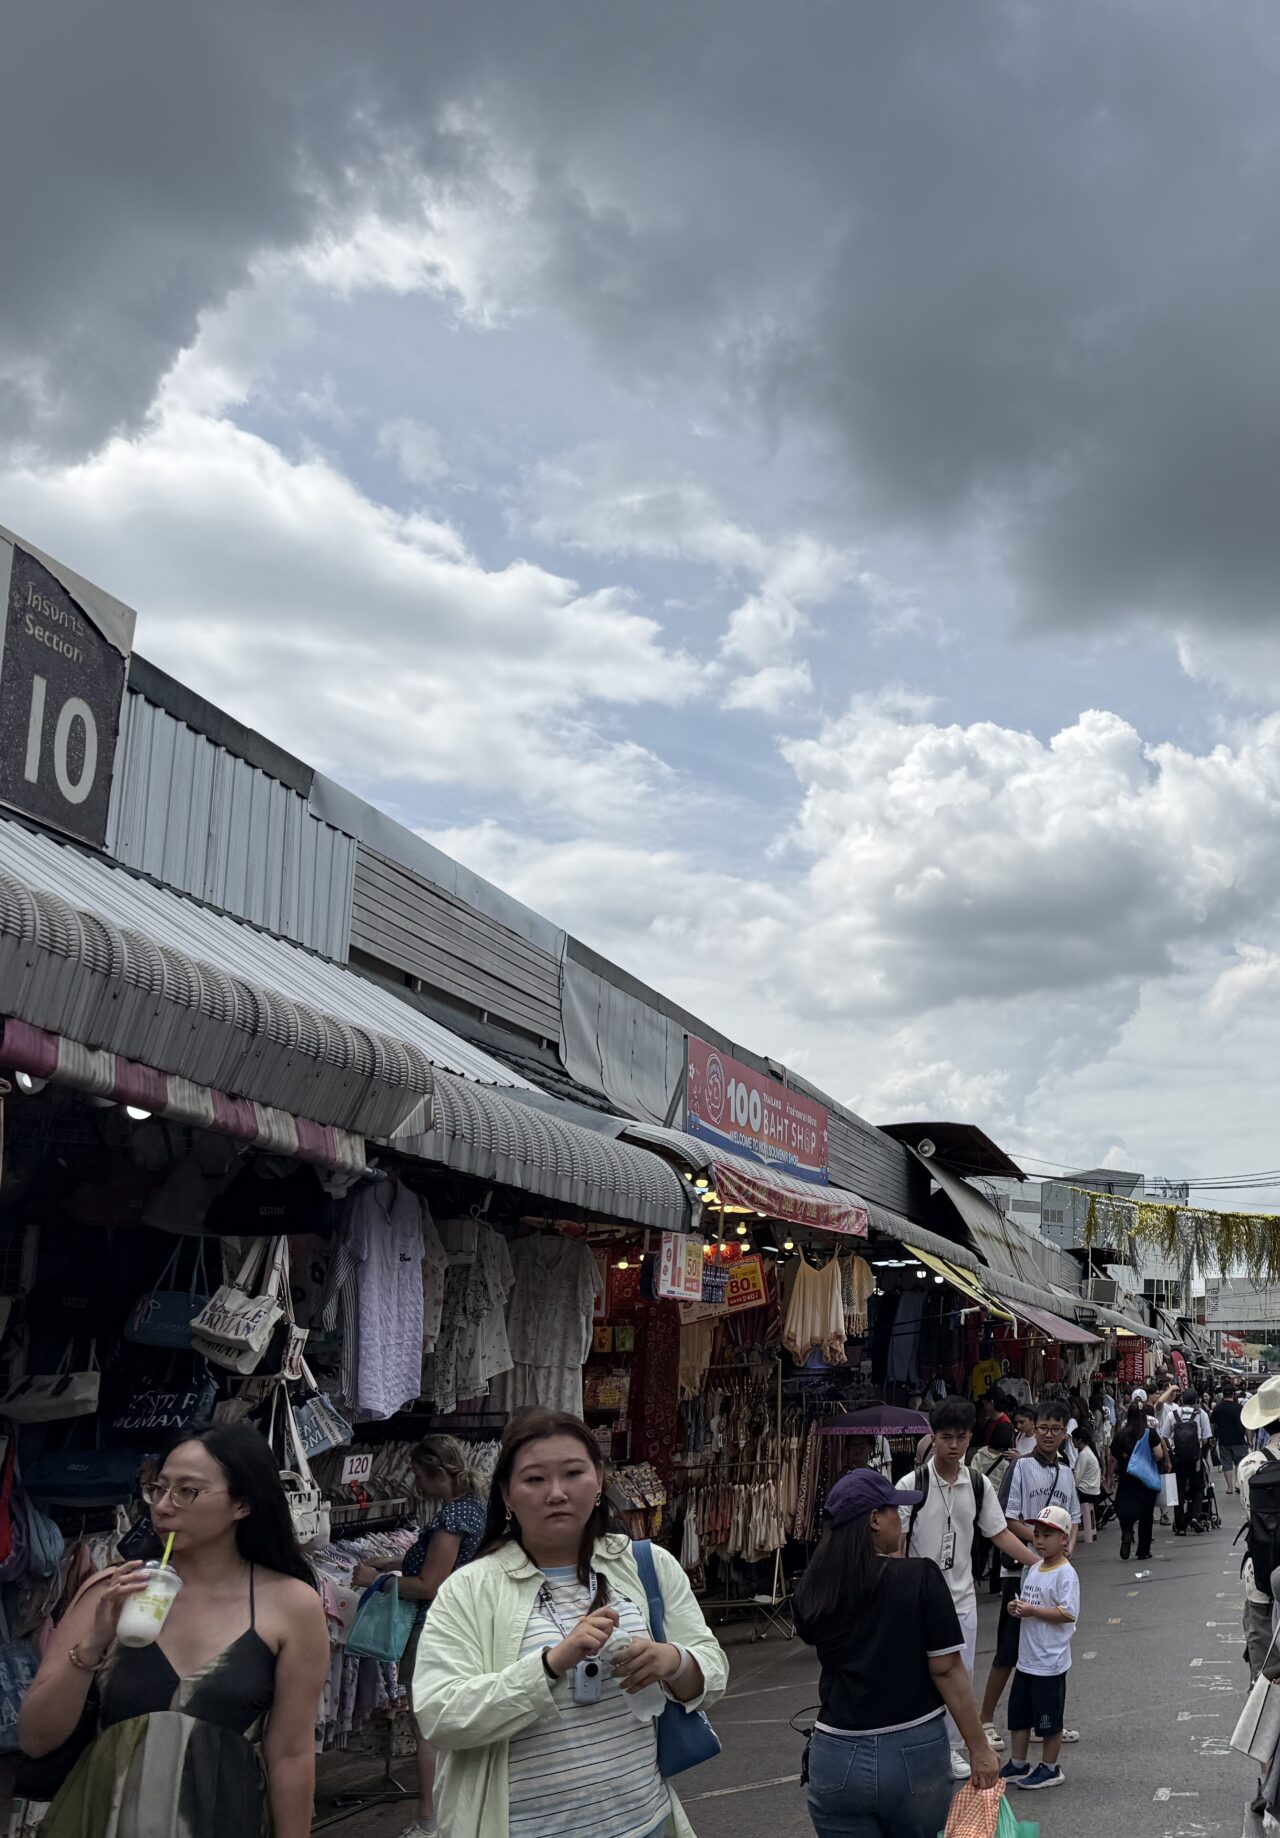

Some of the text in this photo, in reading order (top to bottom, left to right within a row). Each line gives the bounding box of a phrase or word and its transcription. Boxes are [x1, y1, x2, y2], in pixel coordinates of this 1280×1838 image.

[25, 614, 83, 664] Section
[24, 674, 98, 804] 10
[726, 1078, 762, 1133] 100
[763, 1108, 789, 1143] BAHT
[729, 1277, 751, 1294] 80
[347, 1456, 369, 1475] 120
